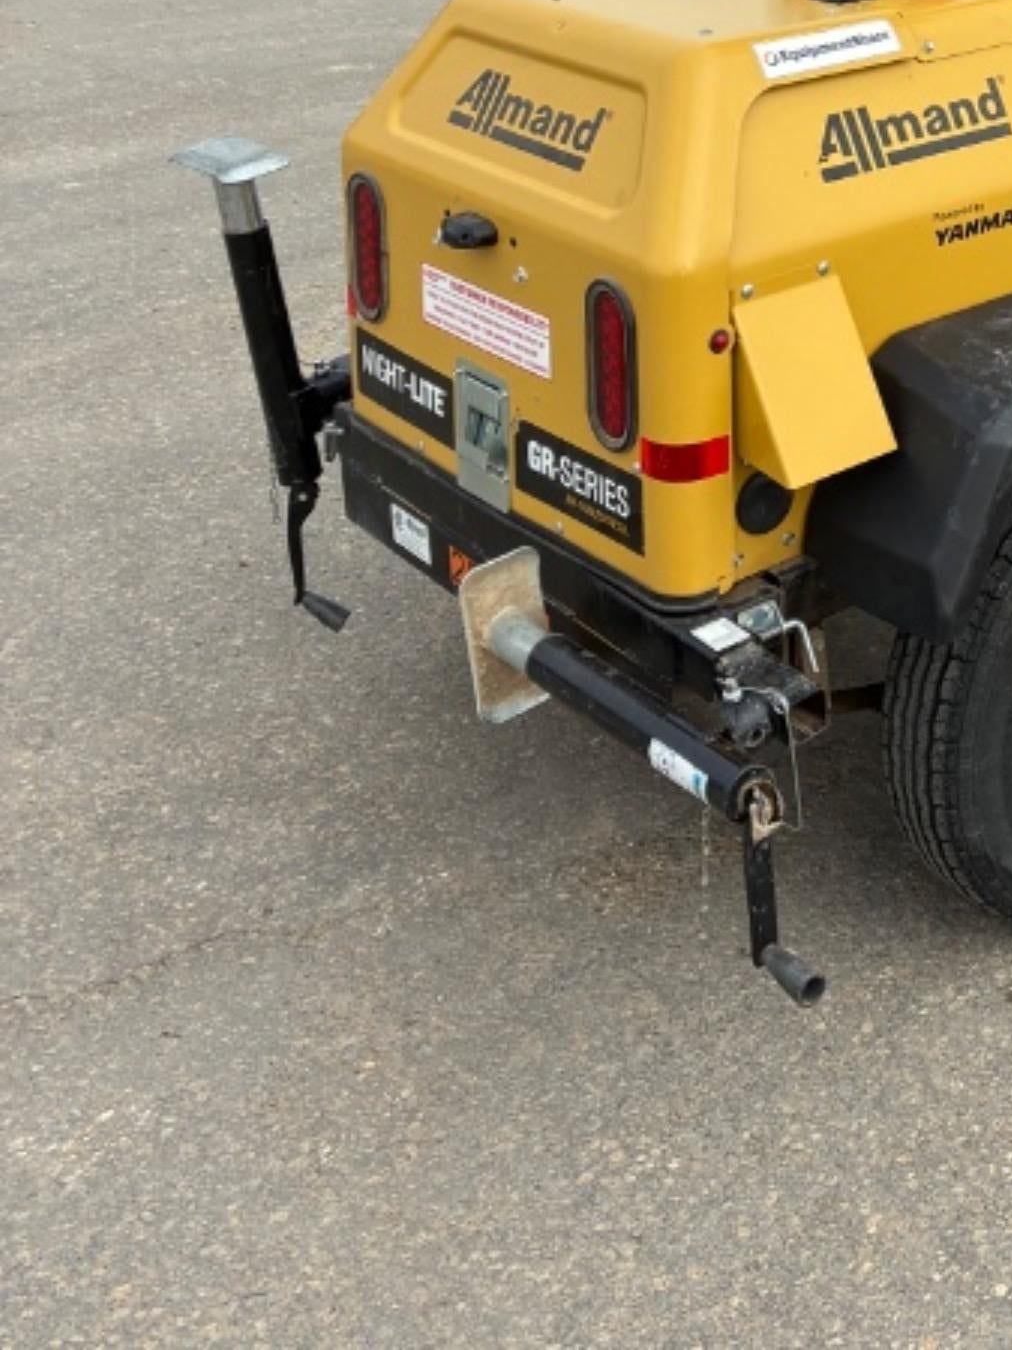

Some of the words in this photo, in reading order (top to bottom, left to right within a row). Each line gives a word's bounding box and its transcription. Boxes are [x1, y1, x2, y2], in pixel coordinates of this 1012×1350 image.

[456, 69, 607, 153] Allmand
[819, 77, 1006, 173] Allmand
[361, 344, 447, 418] NIGHT-LITE
[526, 439, 631, 519] GR-SERIES
